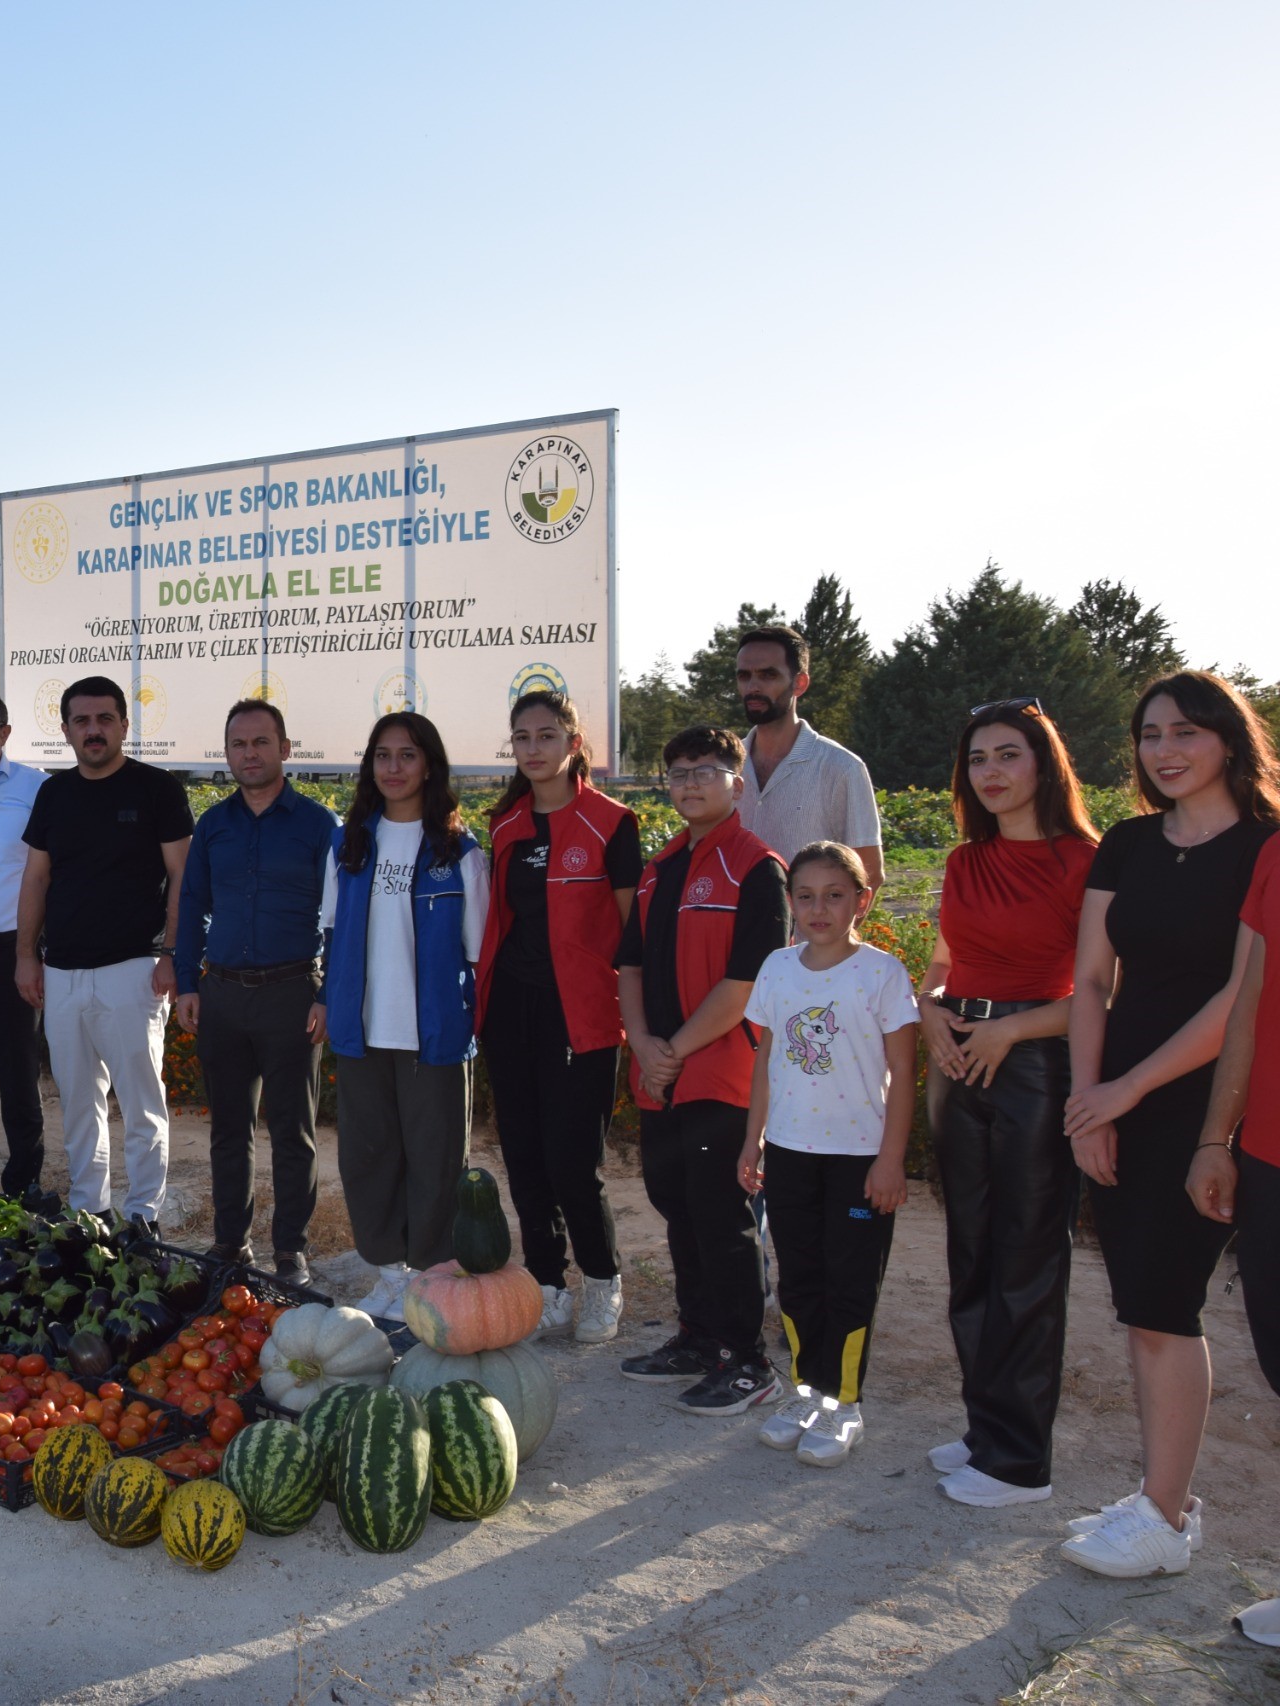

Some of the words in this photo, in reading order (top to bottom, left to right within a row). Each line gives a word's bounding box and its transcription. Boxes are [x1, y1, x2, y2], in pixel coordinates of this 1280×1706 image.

[511, 440, 588, 481] KARAPINAR
[110, 489, 198, 530] GENÇLİK
[205, 489, 232, 518] VE
[239, 482, 299, 514] SPOR
[306, 458, 446, 507] BAKANLIĞI,
[78, 540, 192, 575] KARAPINAR
[199, 519, 327, 564] BELEDİYESİ
[335, 508, 490, 552] DESTEĞİYLE
[513, 505, 585, 540] BELEDİYESİ
[159, 571, 279, 607] DOĞAYLA
[288, 569, 320, 598] EL
[330, 564, 382, 595] ELE
[209, 606, 321, 631] ÜRETİYORUM,
[9, 644, 66, 666] PROJESİ
[69, 641, 133, 664] ORGANİK
[136, 642, 184, 661] TARIM
[187, 641, 207, 659] VE
[210, 635, 259, 662] ÇİLEK
[262, 626, 405, 659] YETİŞTİRİCİLİĞİ
[409, 627, 515, 650] UYGULAMA
[520, 622, 598, 646] SAHASI
